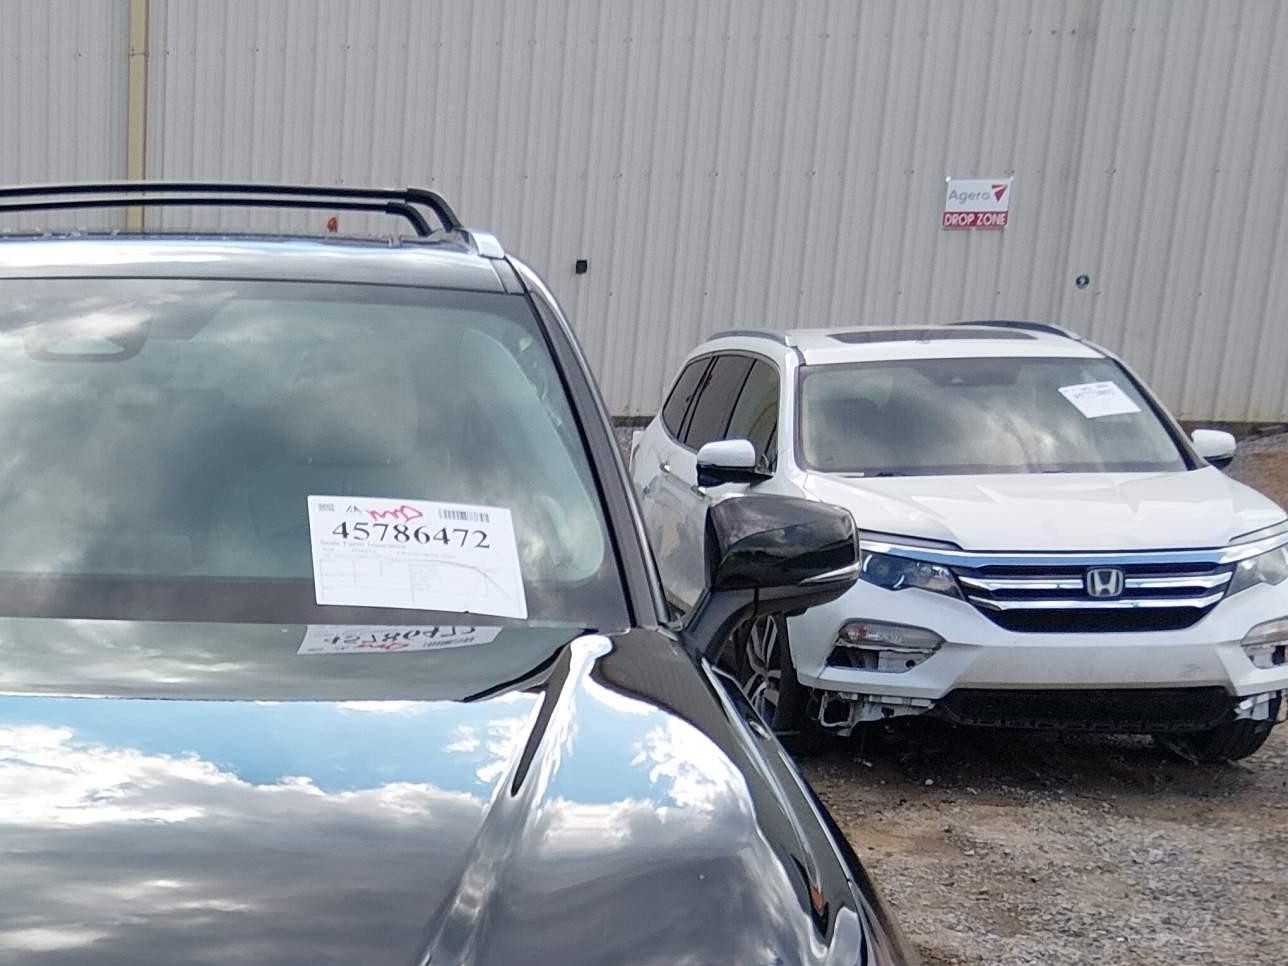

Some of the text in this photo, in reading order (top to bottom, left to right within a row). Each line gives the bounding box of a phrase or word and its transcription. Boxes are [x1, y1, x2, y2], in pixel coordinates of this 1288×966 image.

[949, 189, 990, 204] Agero
[944, 213, 1006, 226] DROP ZONE
[332, 521, 490, 549] 45786472
